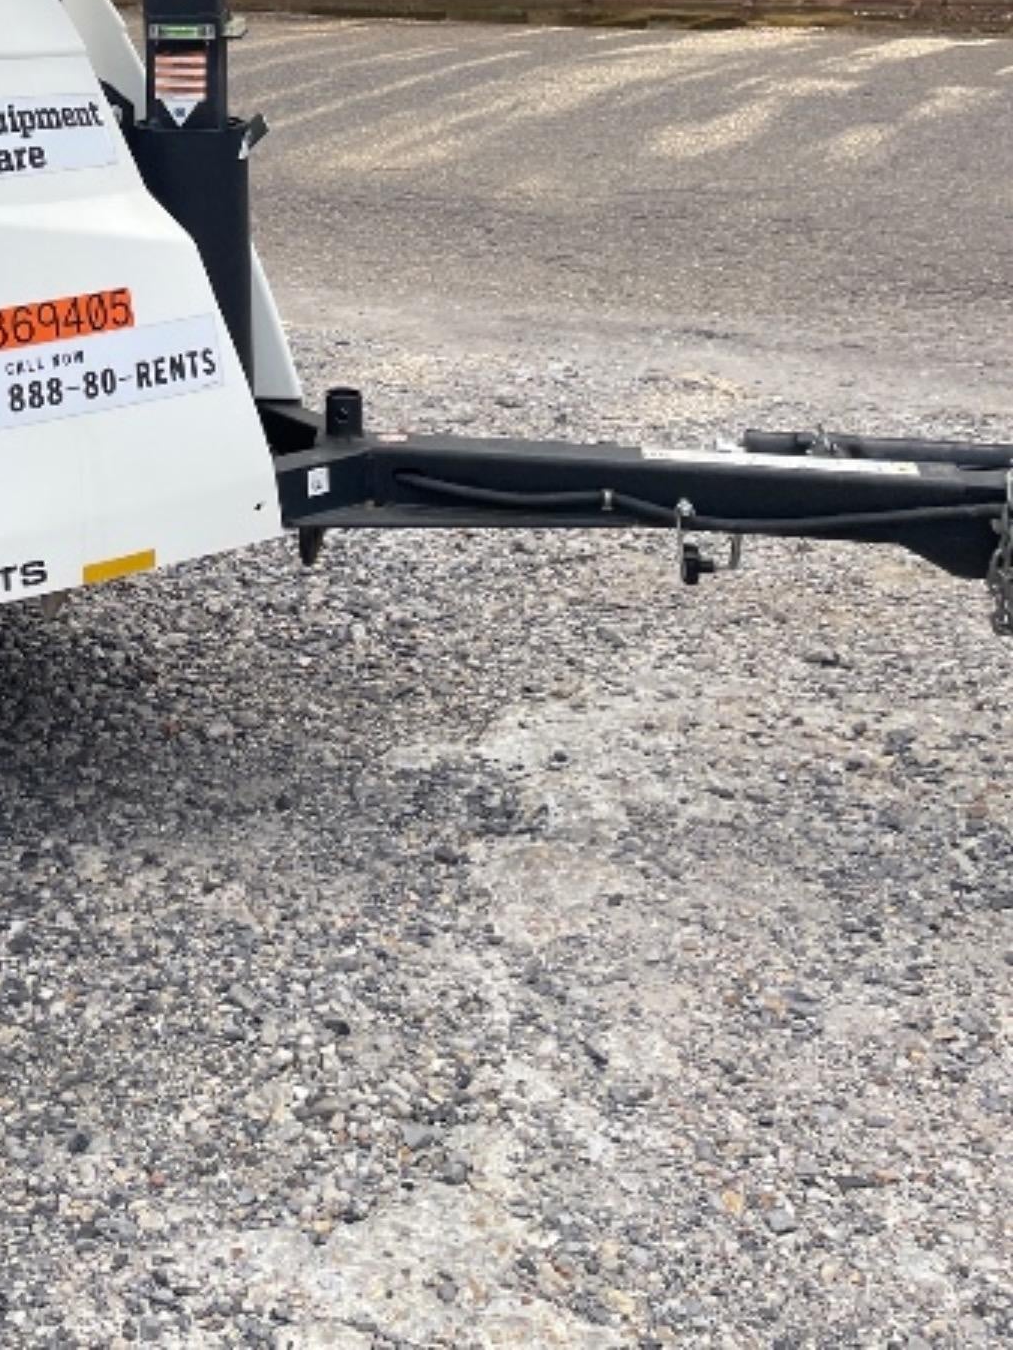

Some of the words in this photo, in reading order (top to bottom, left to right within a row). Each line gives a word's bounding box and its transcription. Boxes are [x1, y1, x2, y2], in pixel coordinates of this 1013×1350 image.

[4, 358, 45, 376] CALL
[52, 350, 85, 368] NOW
[8, 347, 217, 413] 888-80-RENTS
